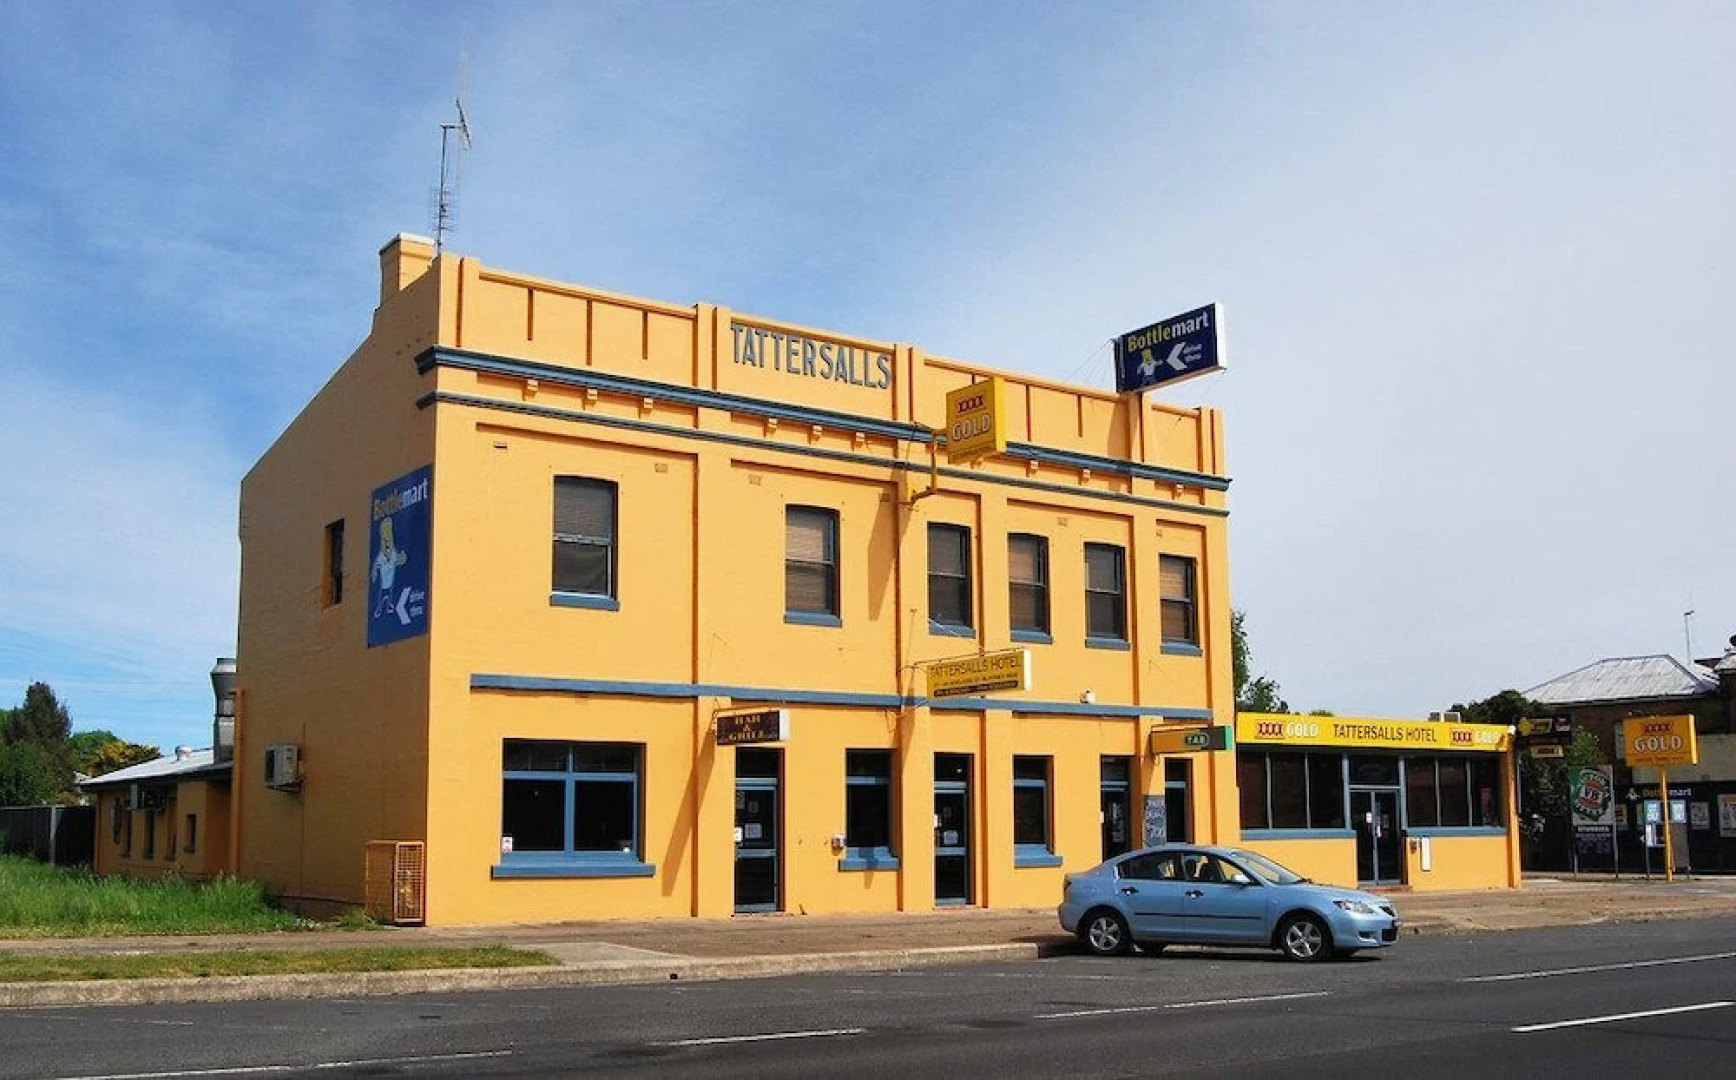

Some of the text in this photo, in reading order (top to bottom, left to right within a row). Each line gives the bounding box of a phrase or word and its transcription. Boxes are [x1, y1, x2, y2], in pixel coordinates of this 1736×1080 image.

[1127, 311, 1209, 352] Bottlemart
[731, 322, 893, 389] TATTERSALLS
[952, 412, 991, 441] GOLD
[930, 655, 1021, 678] TATTERSALLS HOTEL
[1287, 721, 1319, 737] GOLD
[1333, 723, 1403, 741] TATTERSALLS
[1405, 727, 1437, 742] HOTEL
[1634, 735, 1683, 753] GOLD
